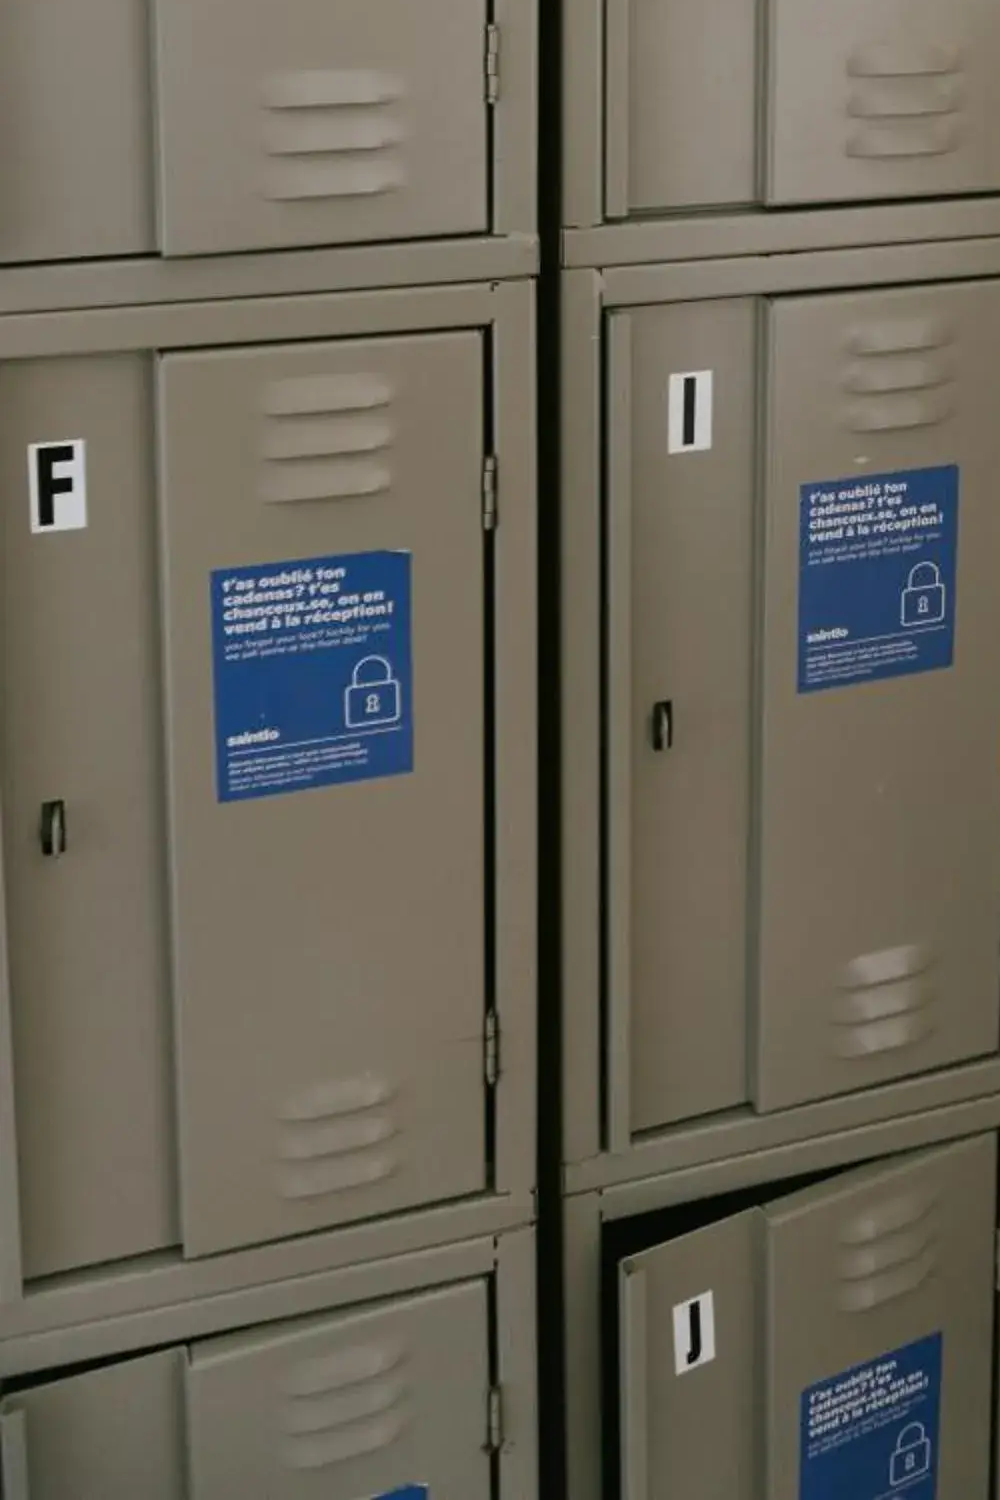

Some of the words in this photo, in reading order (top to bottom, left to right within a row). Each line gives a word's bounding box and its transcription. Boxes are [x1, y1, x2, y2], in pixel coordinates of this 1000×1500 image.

[683, 377, 696, 445] I
[37, 445, 74, 526] F
[687, 1300, 702, 1364] J
